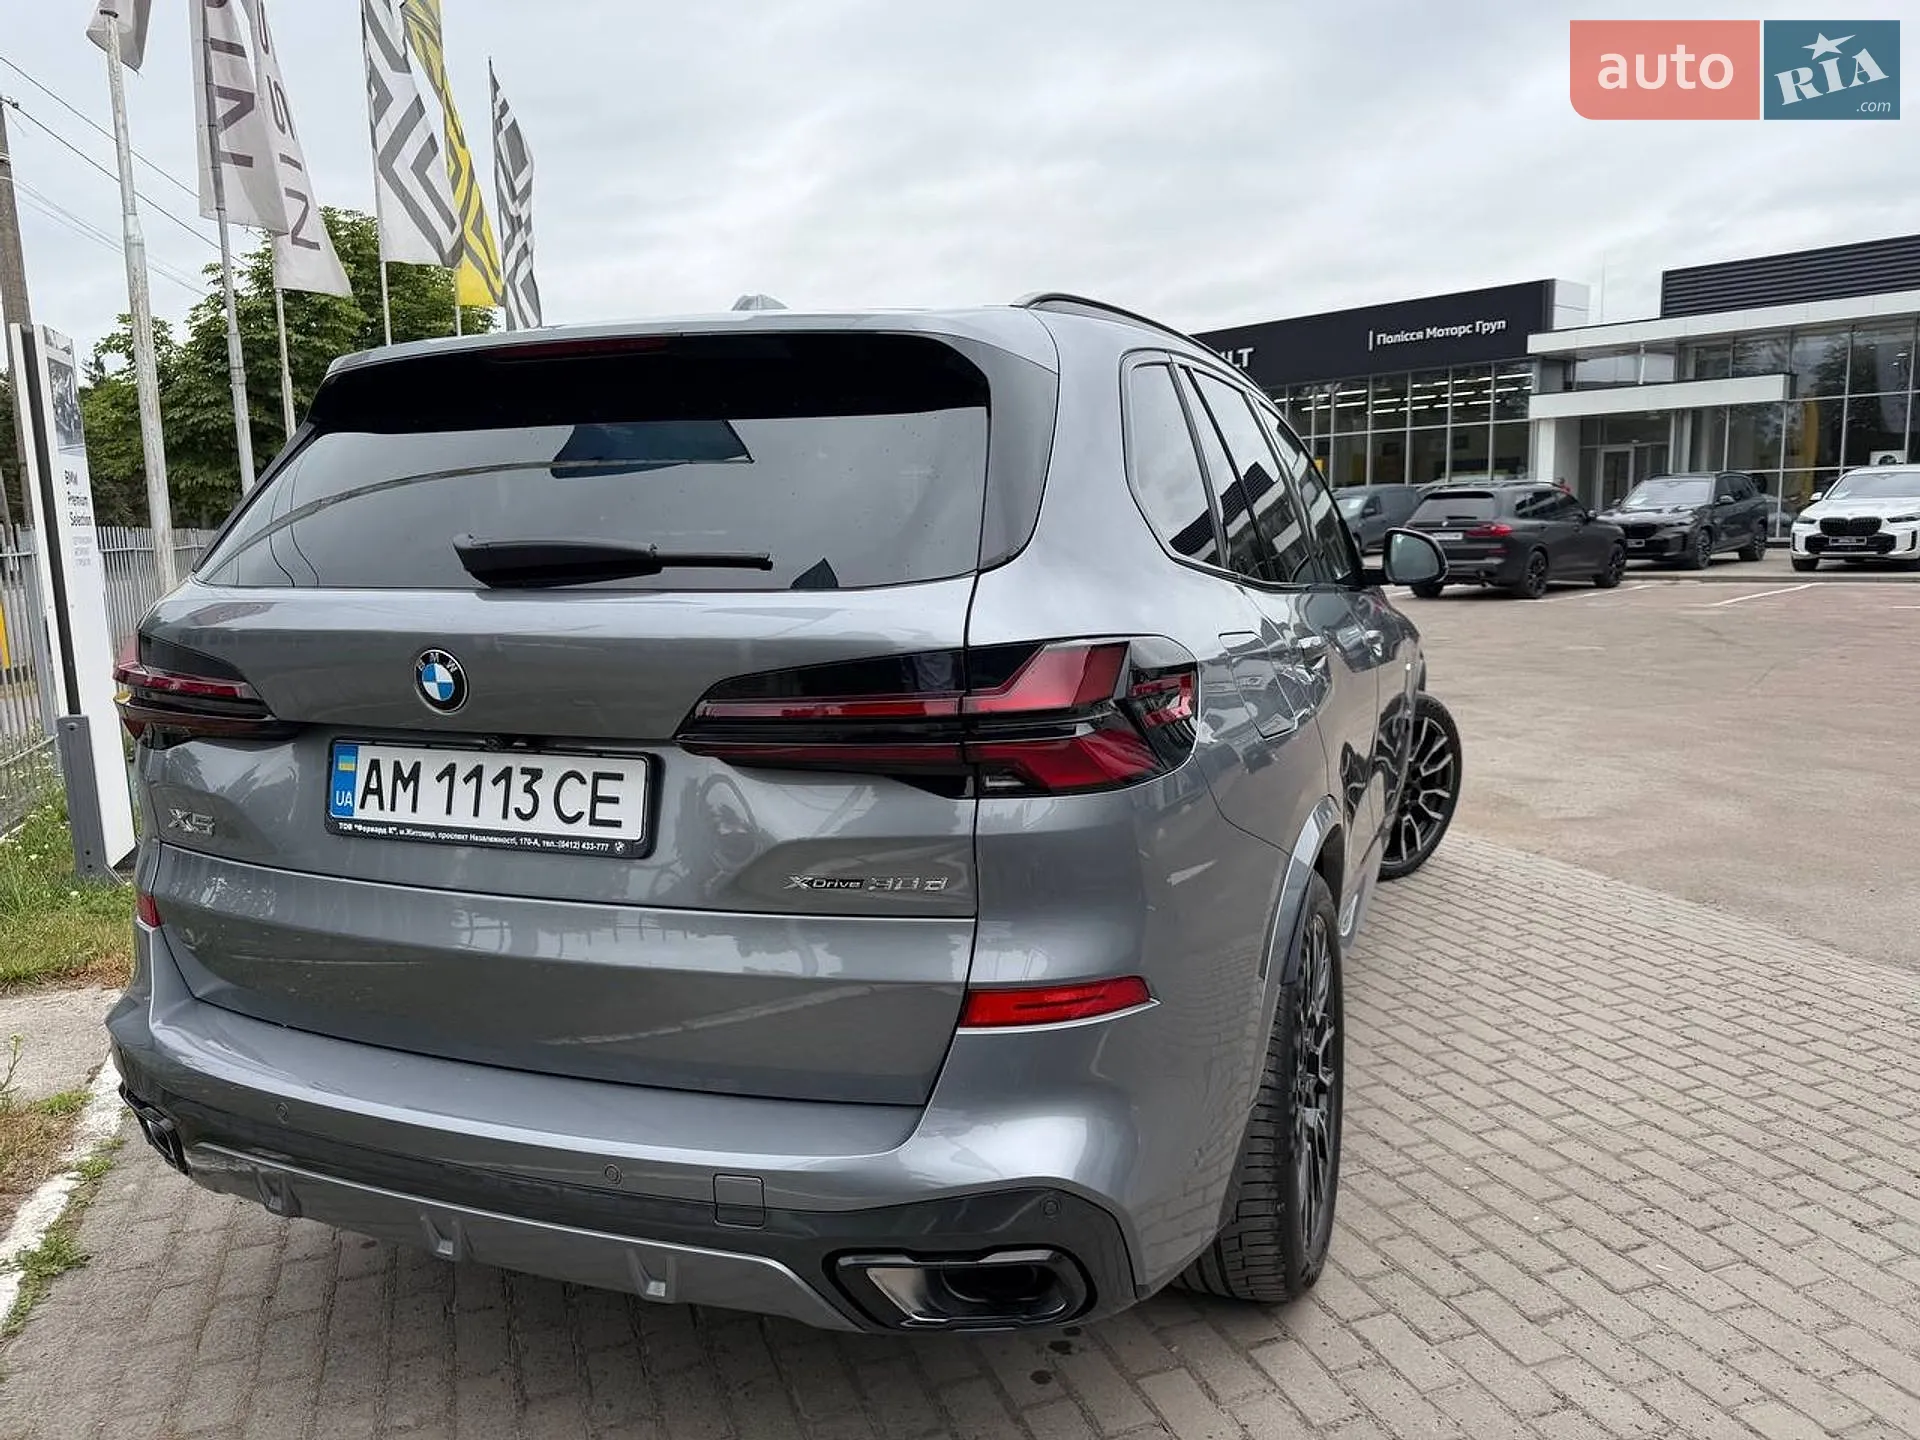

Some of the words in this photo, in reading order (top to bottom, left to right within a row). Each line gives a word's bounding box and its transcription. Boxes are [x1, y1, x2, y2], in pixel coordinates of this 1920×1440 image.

[1376, 330, 1424, 346] Полісся
[1425, 323, 1473, 339] Моторс
[1474, 319, 1506, 335] Груп
[335, 789, 354, 807] UA
[358, 758, 422, 814] AM
[435, 762, 543, 822] 1113
[553, 769, 625, 829] CE
[168, 808, 214, 835] X5
